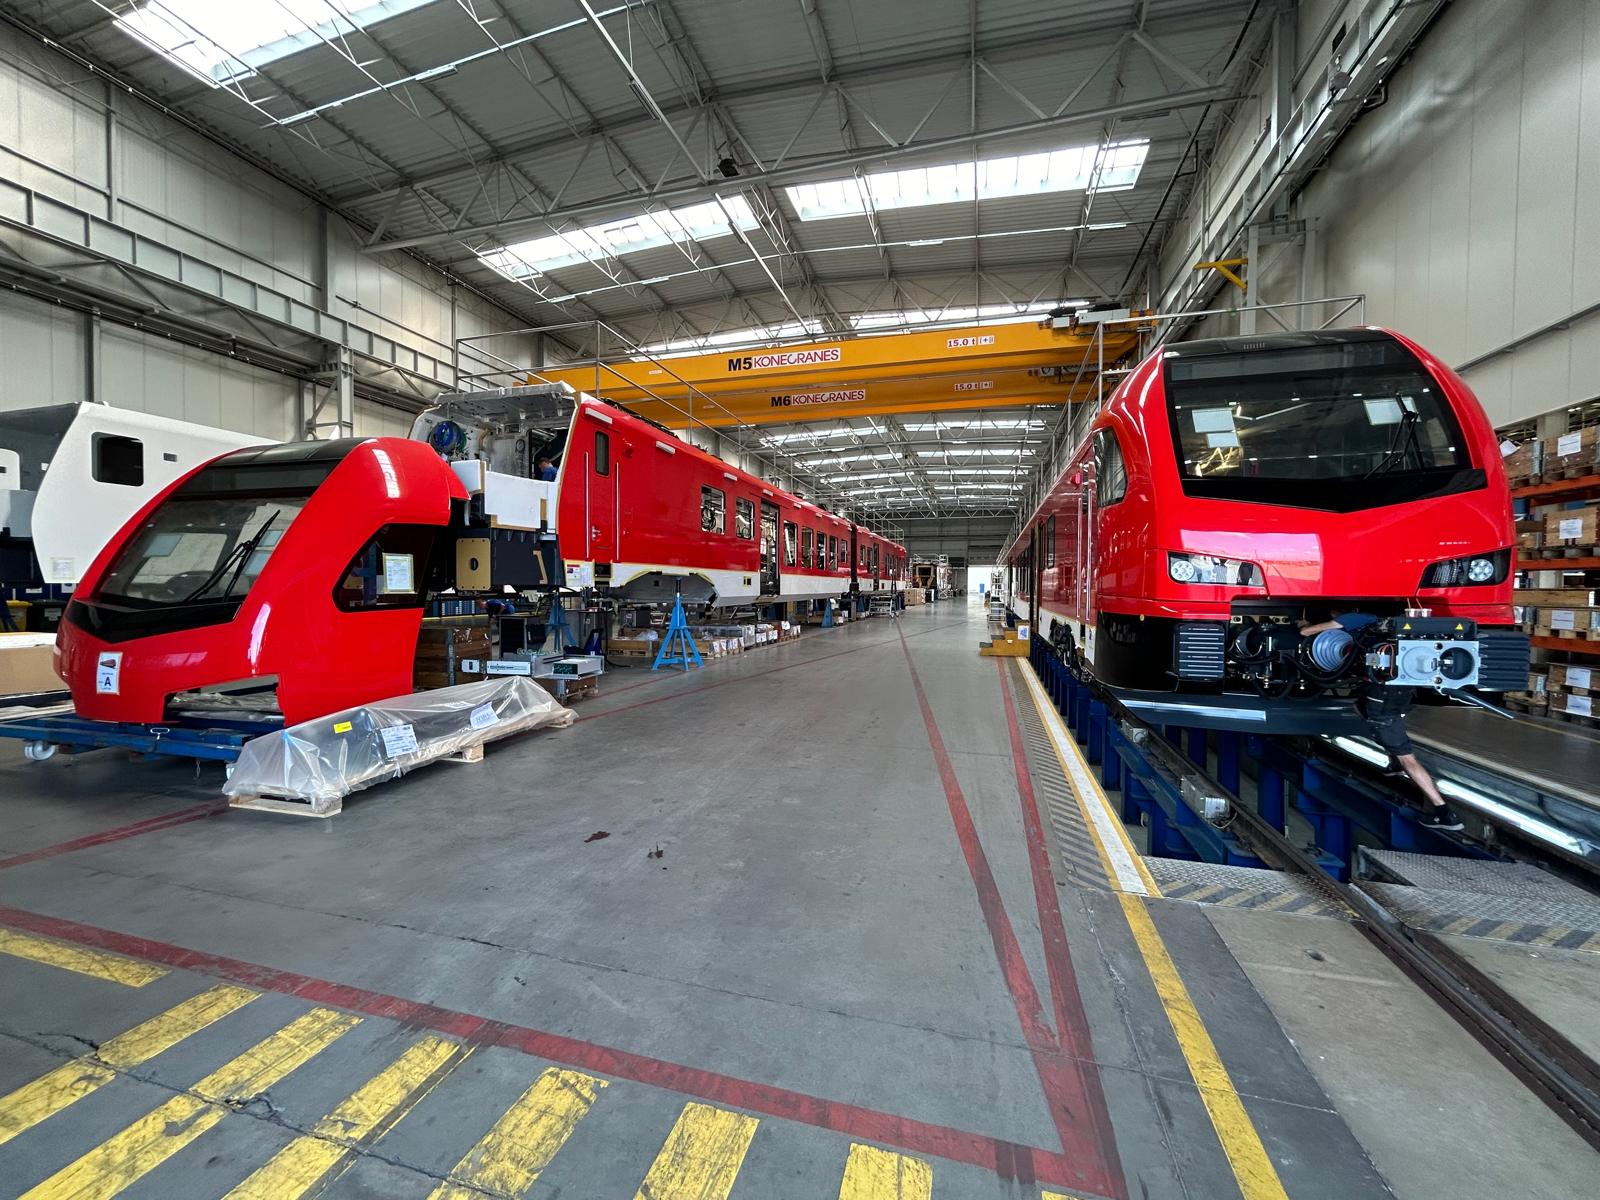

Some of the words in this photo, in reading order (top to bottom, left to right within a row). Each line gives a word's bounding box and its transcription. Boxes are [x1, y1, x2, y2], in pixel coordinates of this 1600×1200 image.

[948, 338, 969, 348] 15.0
[728, 357, 753, 372] M5
[753, 349, 839, 368] KONECRANES
[955, 383, 973, 391] 15.0
[771, 395, 791, 407] M6
[792, 390, 865, 405] KONECRANES
[104, 676, 112, 687] A
